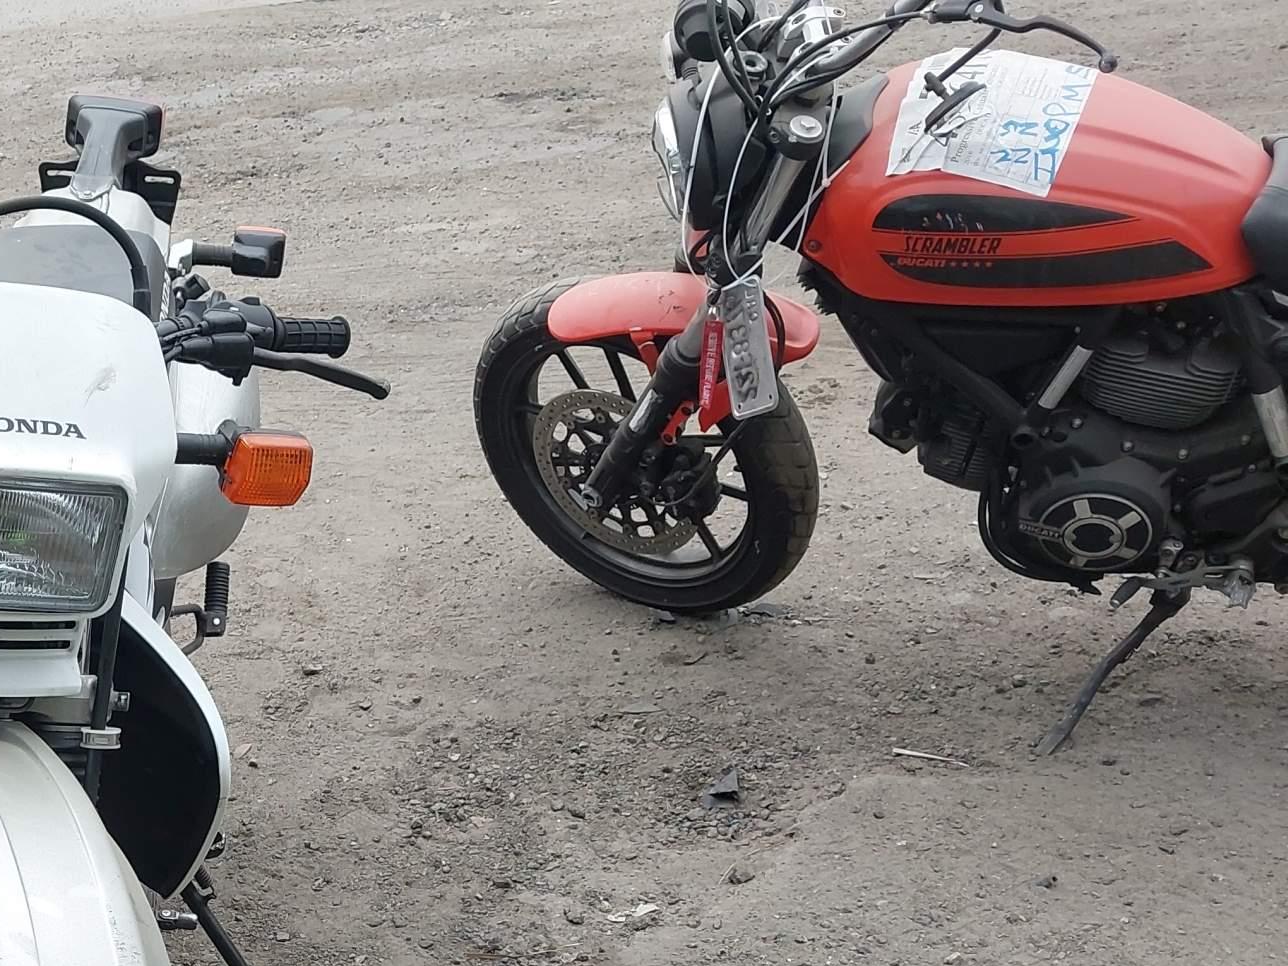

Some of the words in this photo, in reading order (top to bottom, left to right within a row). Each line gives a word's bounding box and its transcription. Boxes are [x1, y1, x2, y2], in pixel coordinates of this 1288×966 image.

[904, 235, 1003, 255] SCRAMBLER
[897, 257, 946, 268] DUCATI
[1018, 523, 1061, 538] DUCATI
